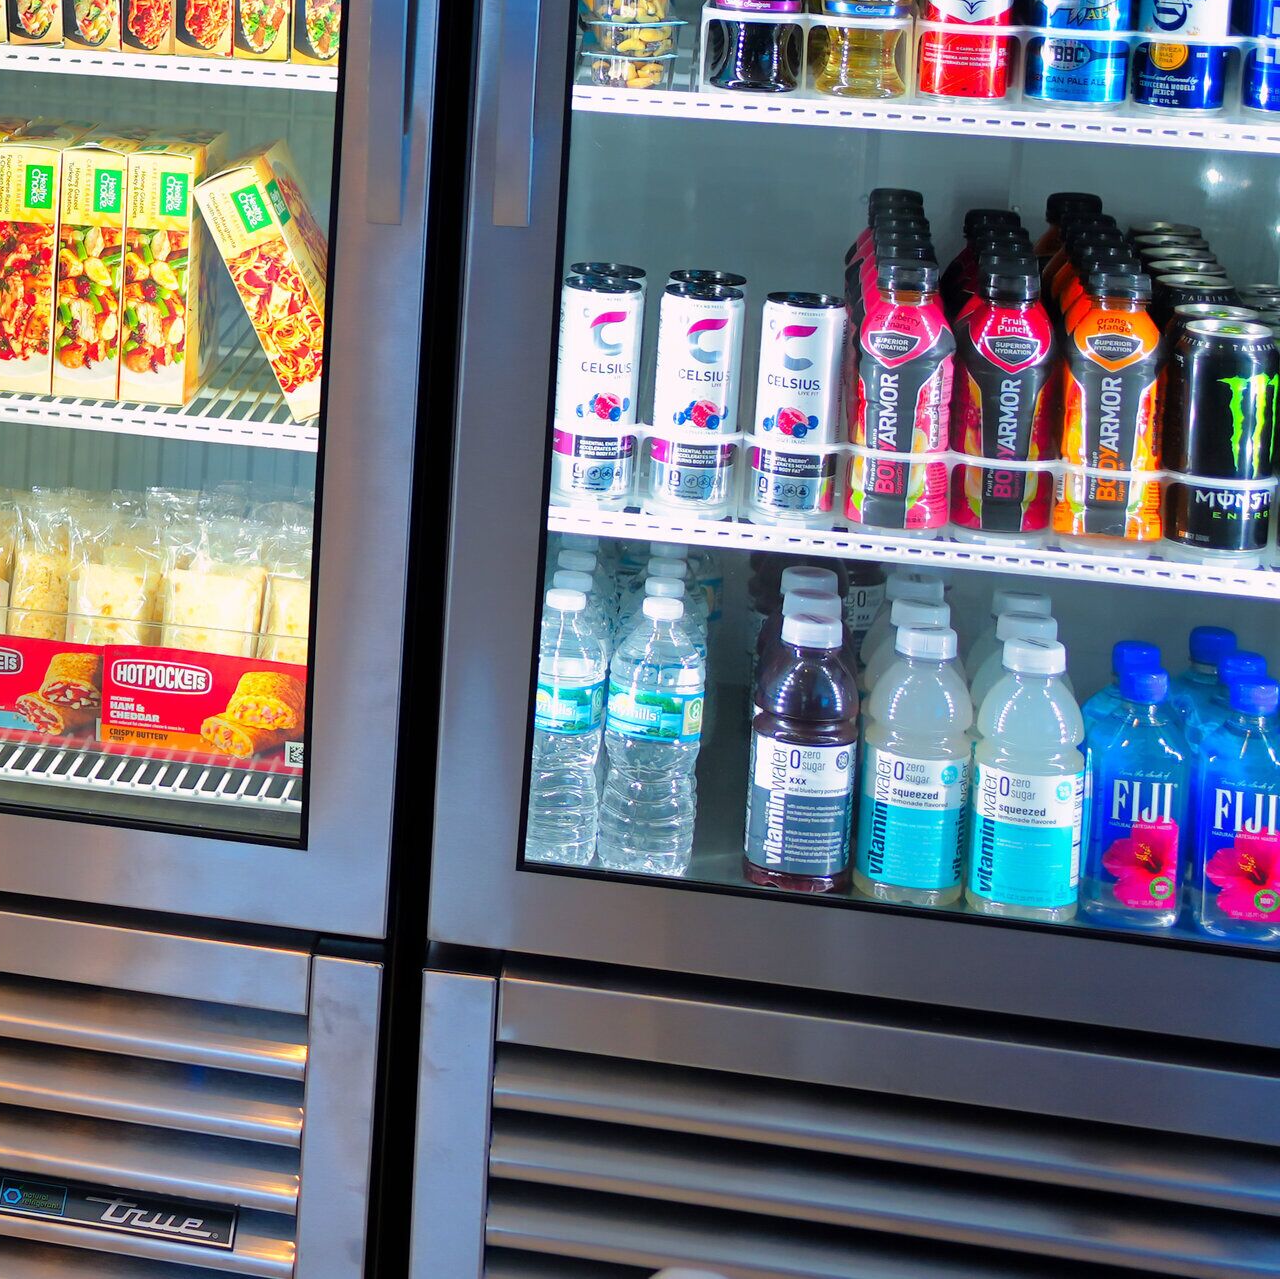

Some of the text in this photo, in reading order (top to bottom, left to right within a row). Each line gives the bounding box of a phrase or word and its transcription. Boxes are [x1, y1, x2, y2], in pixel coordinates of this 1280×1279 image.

[1067, 77, 1089, 85] PALE
[995, 341, 1036, 350] SUPERIOR
[995, 347, 1032, 355] HYDRATION
[767, 374, 820, 391] CELSIUS
[116, 663, 206, 690] HOT POCKETS
[110, 701, 133, 712] HAM
[110, 710, 160, 723] CHEDDAR
[109, 728, 168, 741] CRISPY BUTTERY
[802, 750, 821, 759] zero
[802, 760, 825, 773] sugar
[892, 787, 939, 801] squeezed
[1112, 779, 1174, 822] FIJI
[764, 744, 786, 864] vitaminwater
[1213, 787, 1279, 834] FIJI
[868, 755, 892, 876] vitaminwater
[23, 1191, 49, 1200] natural
[22, 1198, 60, 1211] refrigerant
[86, 1196, 211, 1237] true
